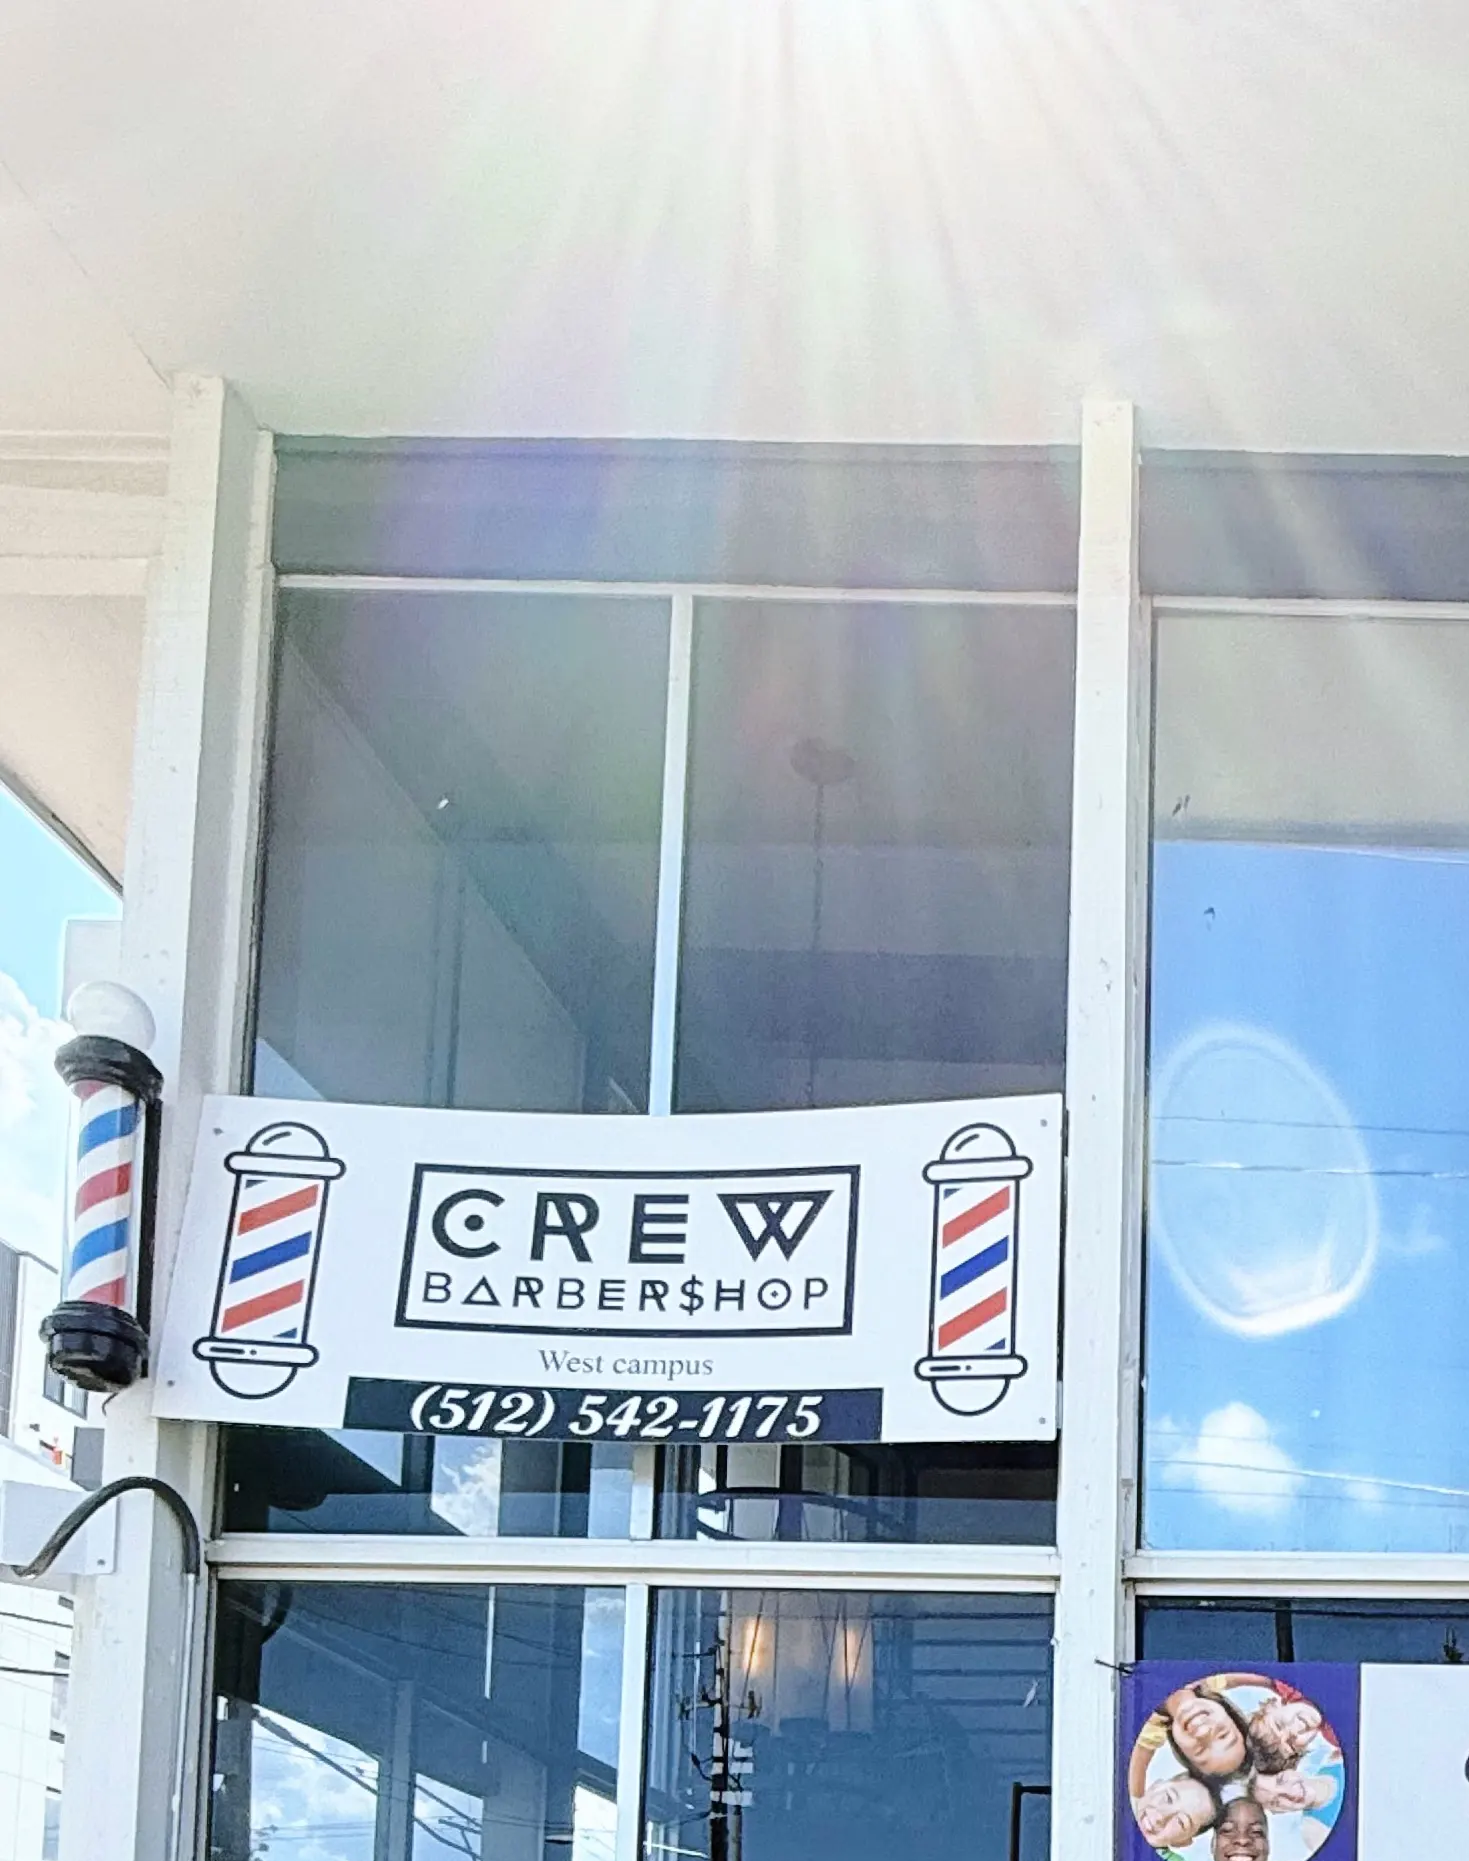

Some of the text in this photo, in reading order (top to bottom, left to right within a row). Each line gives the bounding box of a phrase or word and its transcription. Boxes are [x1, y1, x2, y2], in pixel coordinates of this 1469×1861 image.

[432, 1188, 834, 1264] CREW
[538, 1349, 714, 1380] West campus
[409, 1385, 823, 1438] (512) 542-1175
